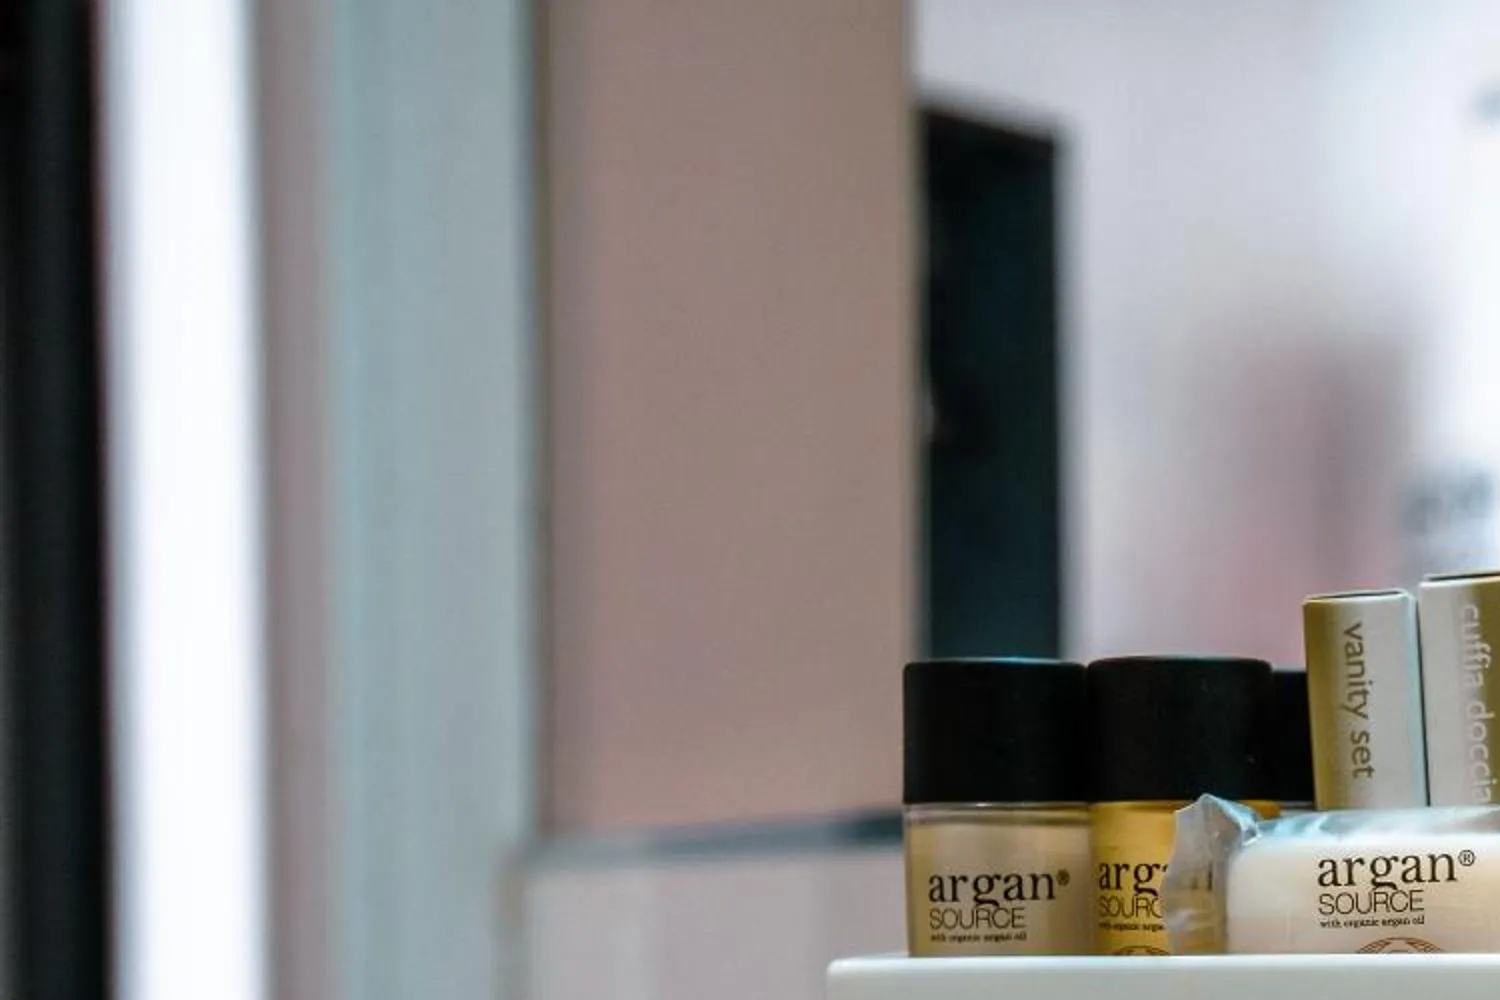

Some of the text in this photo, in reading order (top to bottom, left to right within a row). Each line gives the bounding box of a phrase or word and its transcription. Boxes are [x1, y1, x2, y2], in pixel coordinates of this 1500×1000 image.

[1341, 621, 1376, 779] vanity set
[1463, 604, 1498, 803] cuffia doccia
[1098, 863, 1169, 896] arg
[1099, 895, 1164, 918] SOURC
[1318, 889, 1425, 915] SOURCE
[929, 907, 1027, 930] SOURCE
